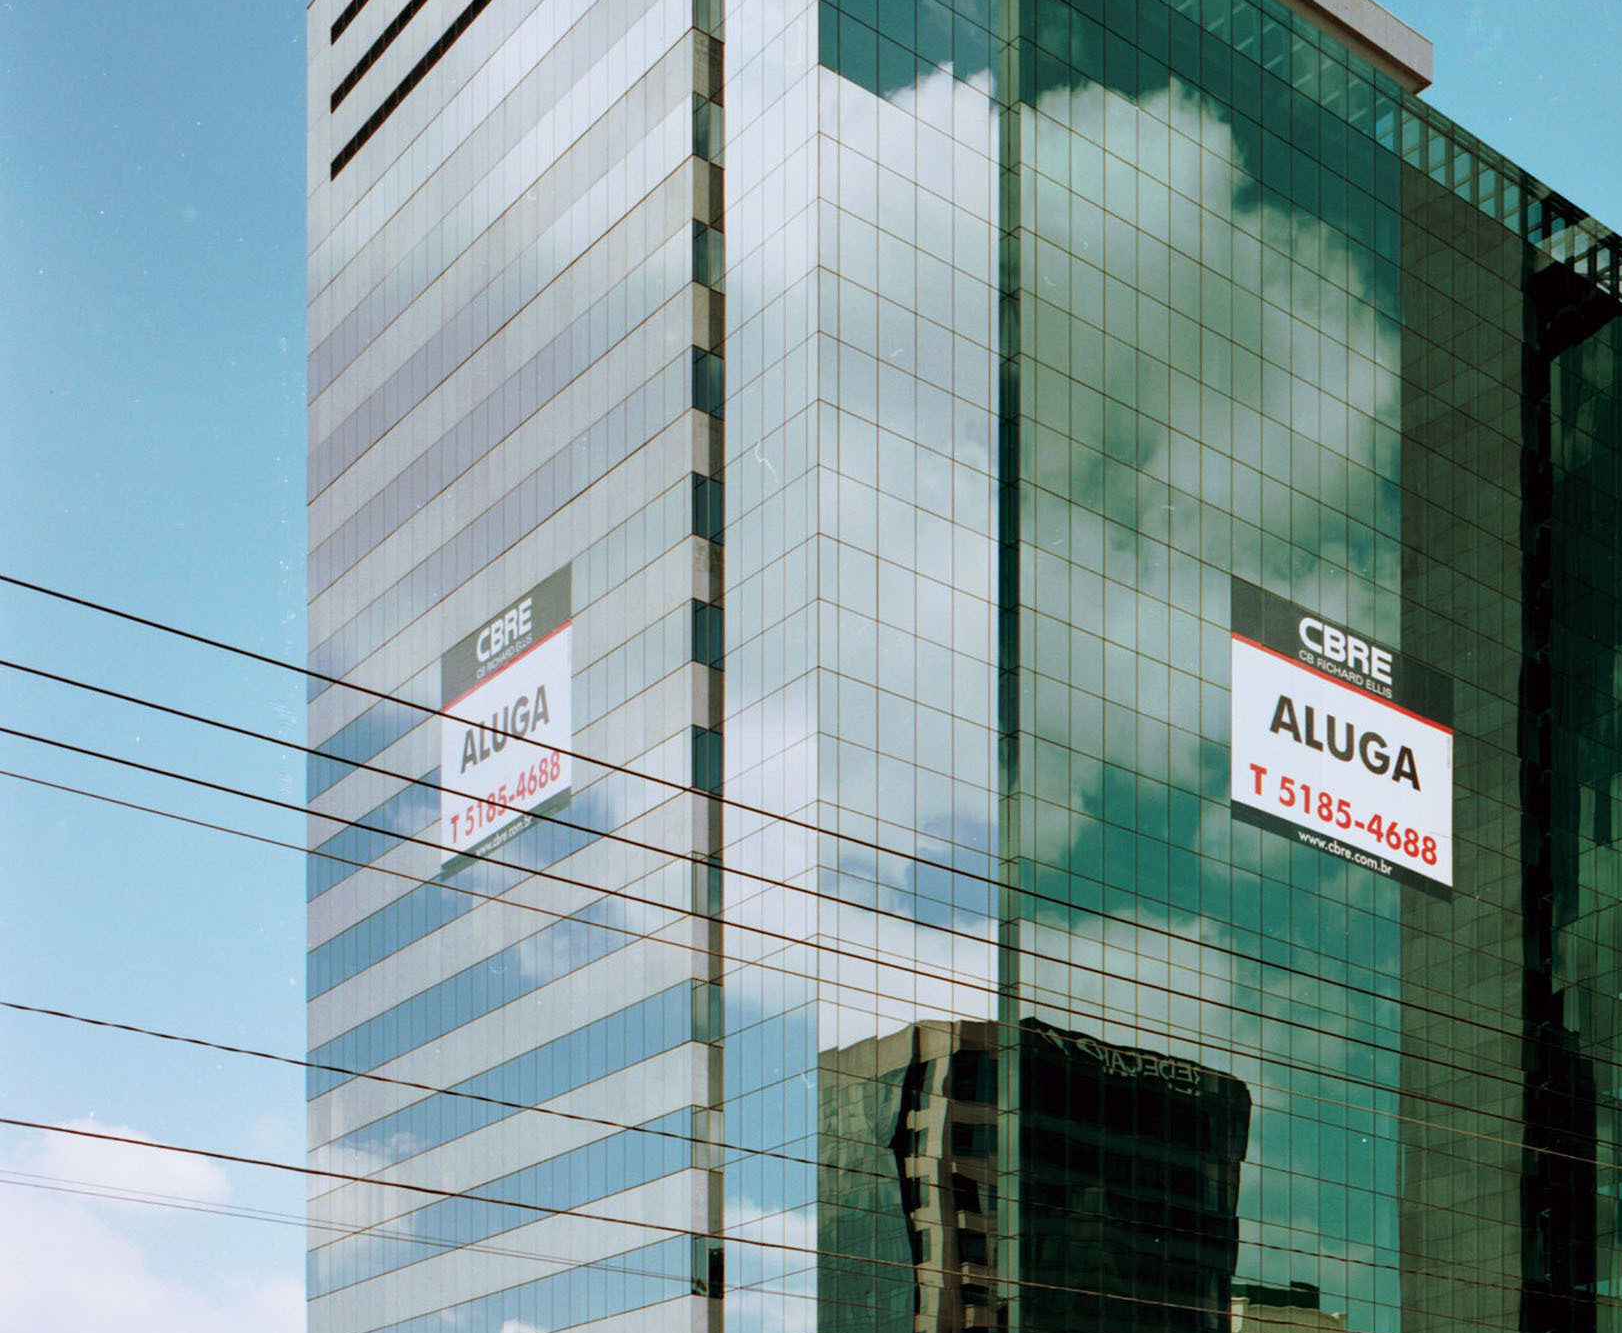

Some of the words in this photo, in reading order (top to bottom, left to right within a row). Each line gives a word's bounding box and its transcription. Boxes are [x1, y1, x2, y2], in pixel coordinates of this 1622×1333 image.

[476, 597, 532, 663] CBRE
[1299, 617, 1393, 685] CBRE
[1299, 650, 1314, 665] CB
[1316, 657, 1364, 686] RICHARD
[1366, 678, 1393, 699] ELLIS
[460, 684, 550, 774] ALUGA
[1269, 694, 1421, 792] ALUGA
[450, 813, 460, 844] T
[464, 749, 561, 836] 5185-4688
[1249, 763, 1267, 796] T
[1279, 775, 1437, 866] 5185-4688
[1297, 830, 1393, 875] www.cbre.com.br
